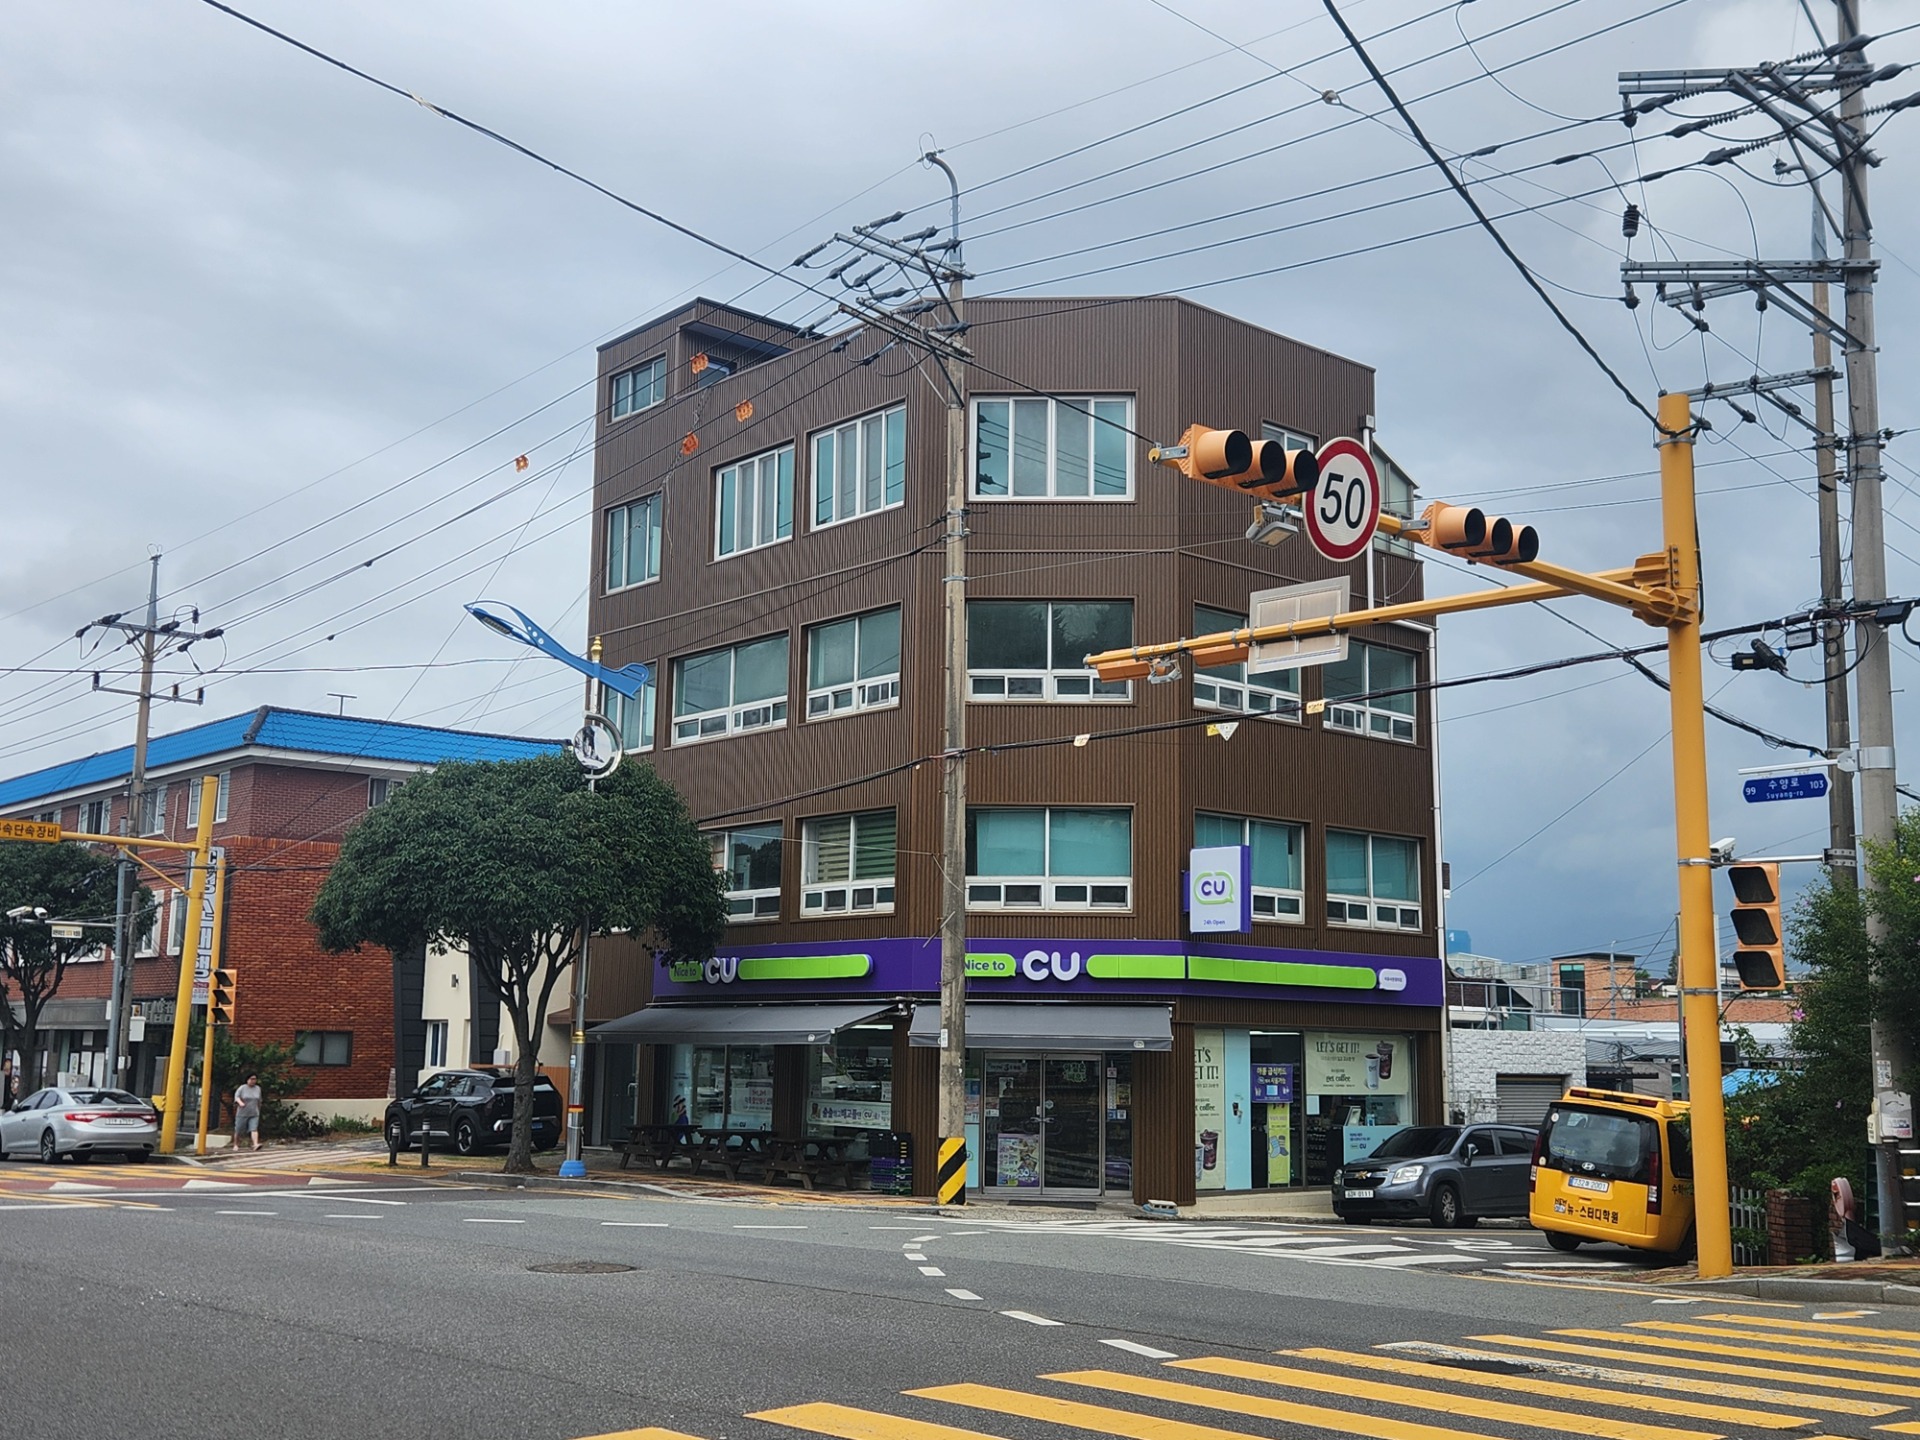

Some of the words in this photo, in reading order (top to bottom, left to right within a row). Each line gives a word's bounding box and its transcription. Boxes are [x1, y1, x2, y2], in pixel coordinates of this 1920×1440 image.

[1320, 472, 1365, 529] 50
[1768, 778, 1800, 790] 수양로
[1809, 780, 1824, 789] 103
[1745, 787, 1757, 796] 99
[1766, 790, 1804, 799] Suyang-ro
[0, 822, 58, 840] 속단속장비
[1201, 880, 1226, 896] CU
[705, 956, 737, 984] CU
[992, 960, 1006, 971] to
[1022, 950, 1080, 981] CU
[1336, 1042, 1349, 1054] GET
[1207, 1066, 1219, 1080] IT!
